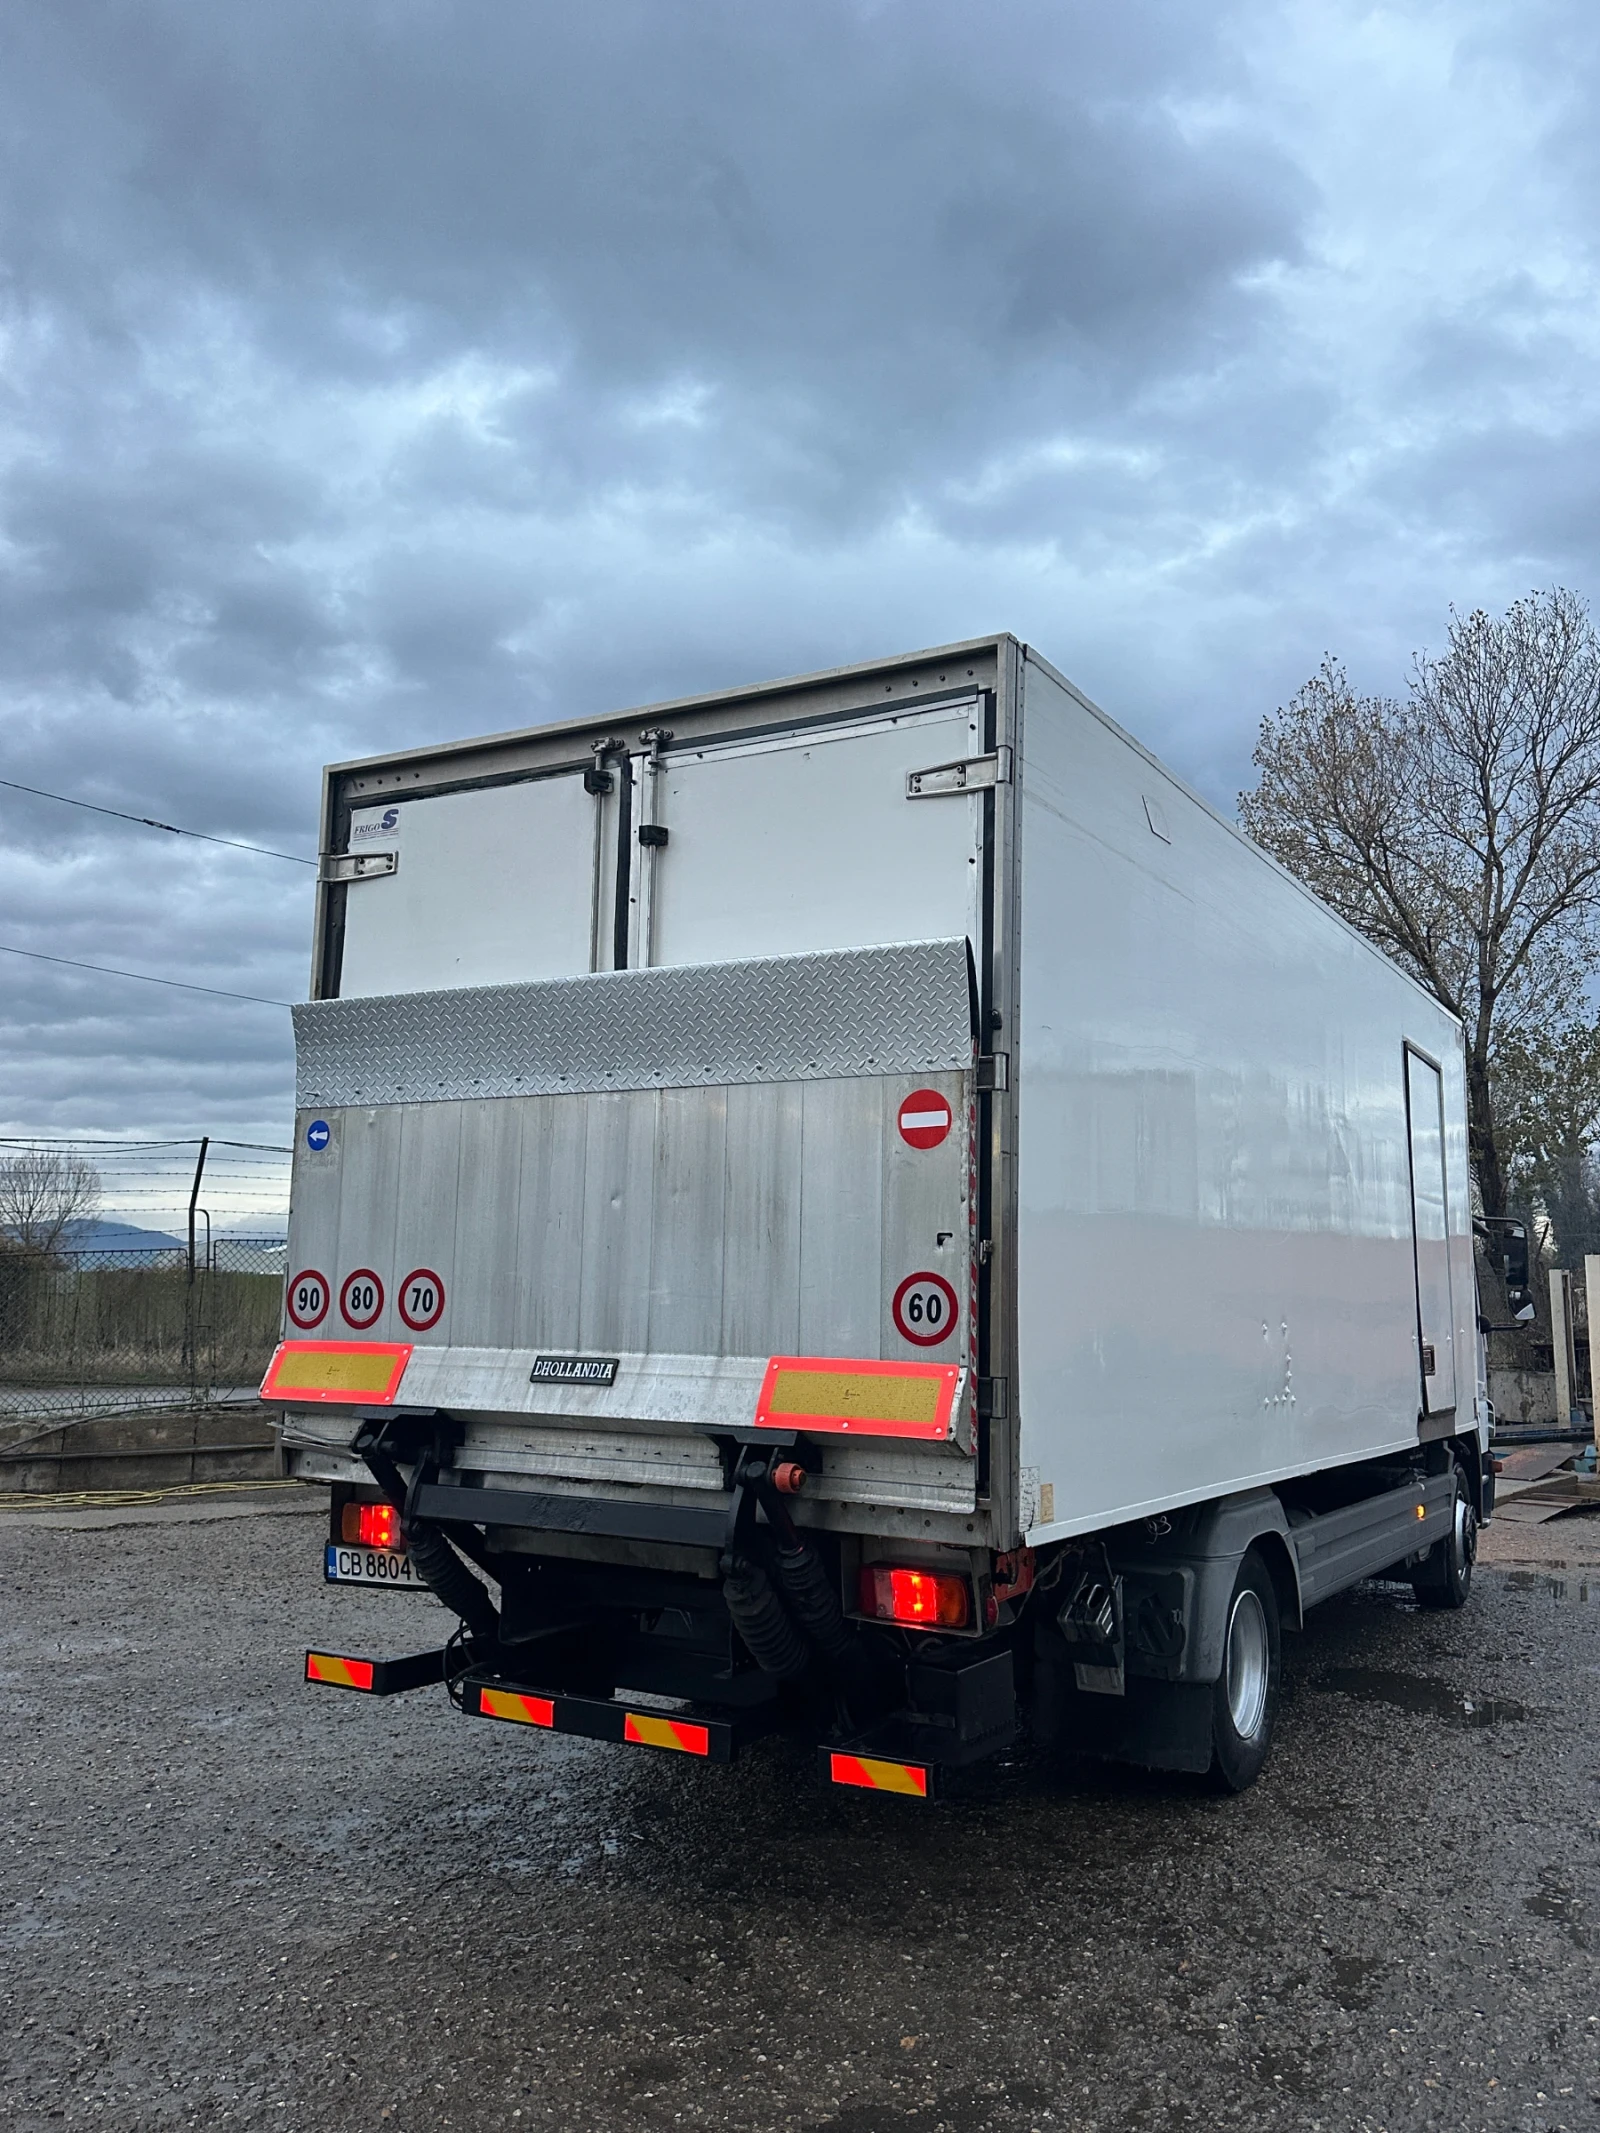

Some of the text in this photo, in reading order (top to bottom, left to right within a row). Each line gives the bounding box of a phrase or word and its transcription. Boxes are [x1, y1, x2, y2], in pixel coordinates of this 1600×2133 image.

[298, 1287, 320, 1311] 90
[351, 1286, 373, 1310] 80
[412, 1287, 433, 1312] 70
[909, 1293, 942, 1323] 60
[533, 1361, 614, 1378] DHOLLANDIA
